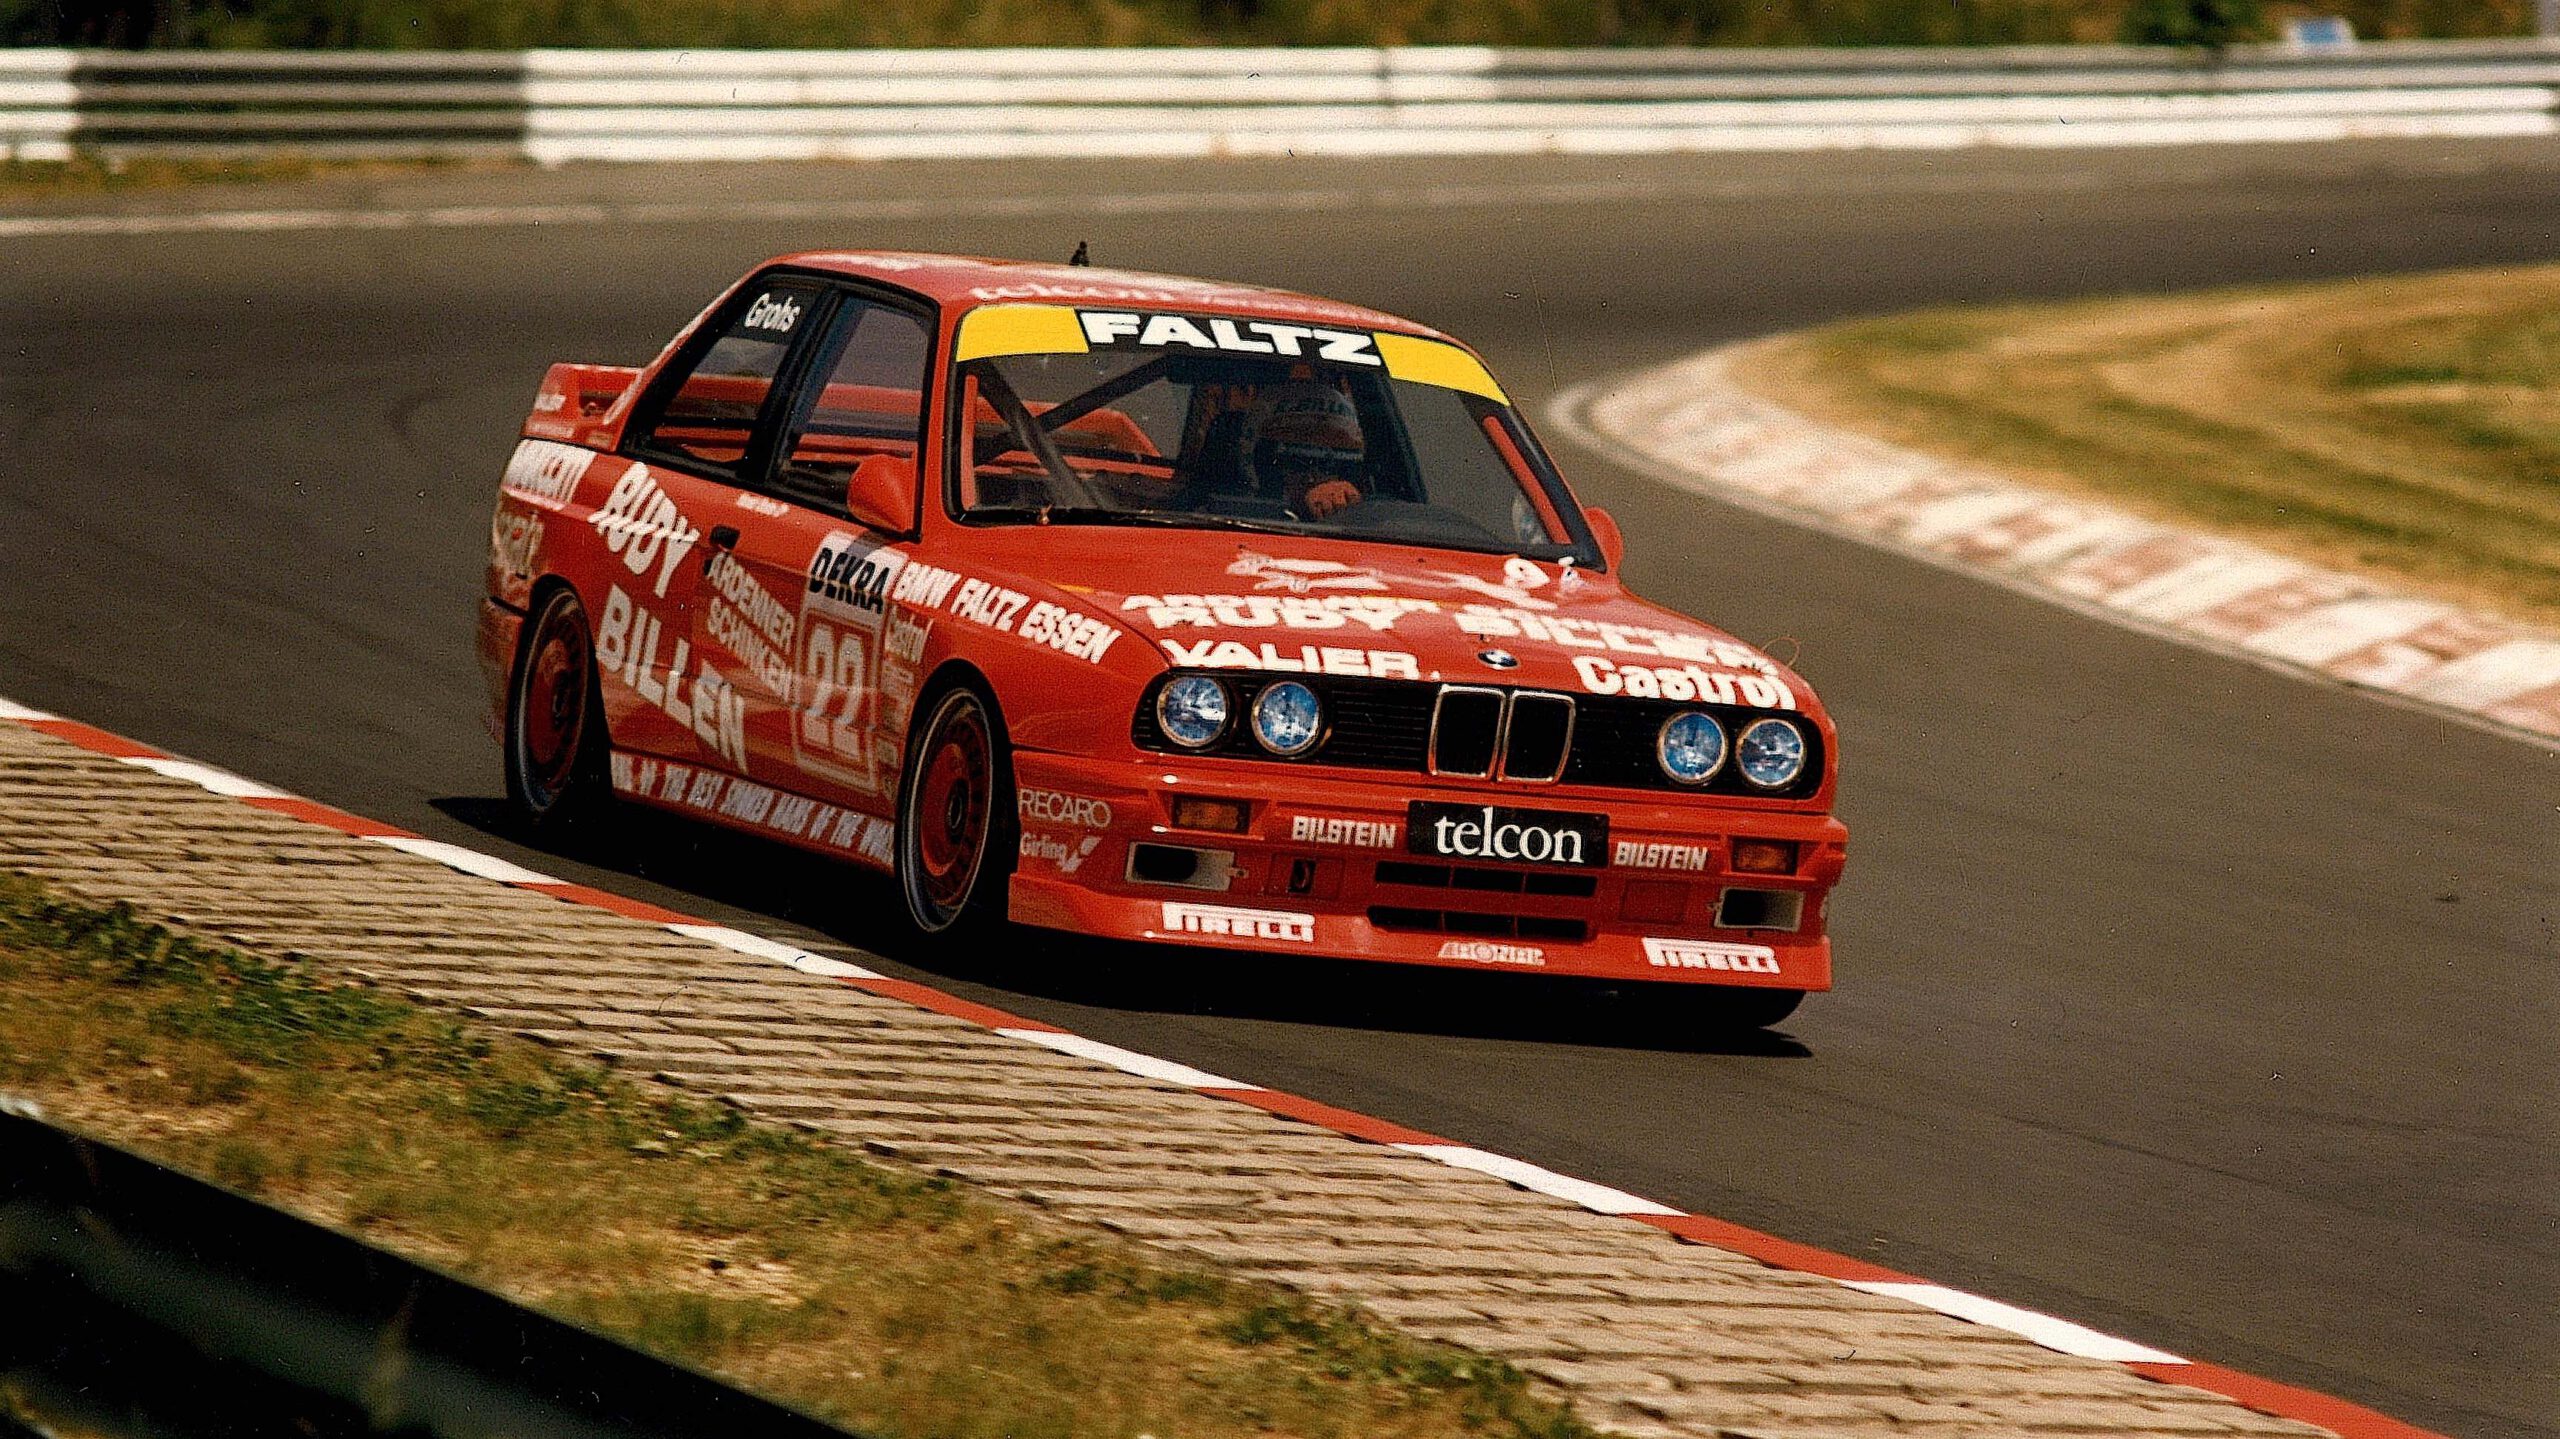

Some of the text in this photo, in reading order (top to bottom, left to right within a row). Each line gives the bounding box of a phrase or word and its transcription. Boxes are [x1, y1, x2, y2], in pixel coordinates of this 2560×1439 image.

[744, 293, 800, 332] Grohs
[1080, 311, 1382, 366] FALTZ
[587, 461, 700, 599] RUDY
[808, 547, 885, 614] DEKRA
[892, 561, 1122, 665] BMW FALTZ ESSEN
[595, 583, 747, 776] BILLEN
[803, 622, 864, 762] 22
[1572, 656, 1797, 711] Castrol
[1018, 788, 1112, 827] RECARO
[1291, 815, 1397, 849] BILSTEIN
[1433, 807, 1585, 864] telcon
[1614, 841, 1708, 872] BILSTEIN
[1162, 901, 1316, 943] PIRELLI
[1642, 936, 1781, 975] PIRELLI
